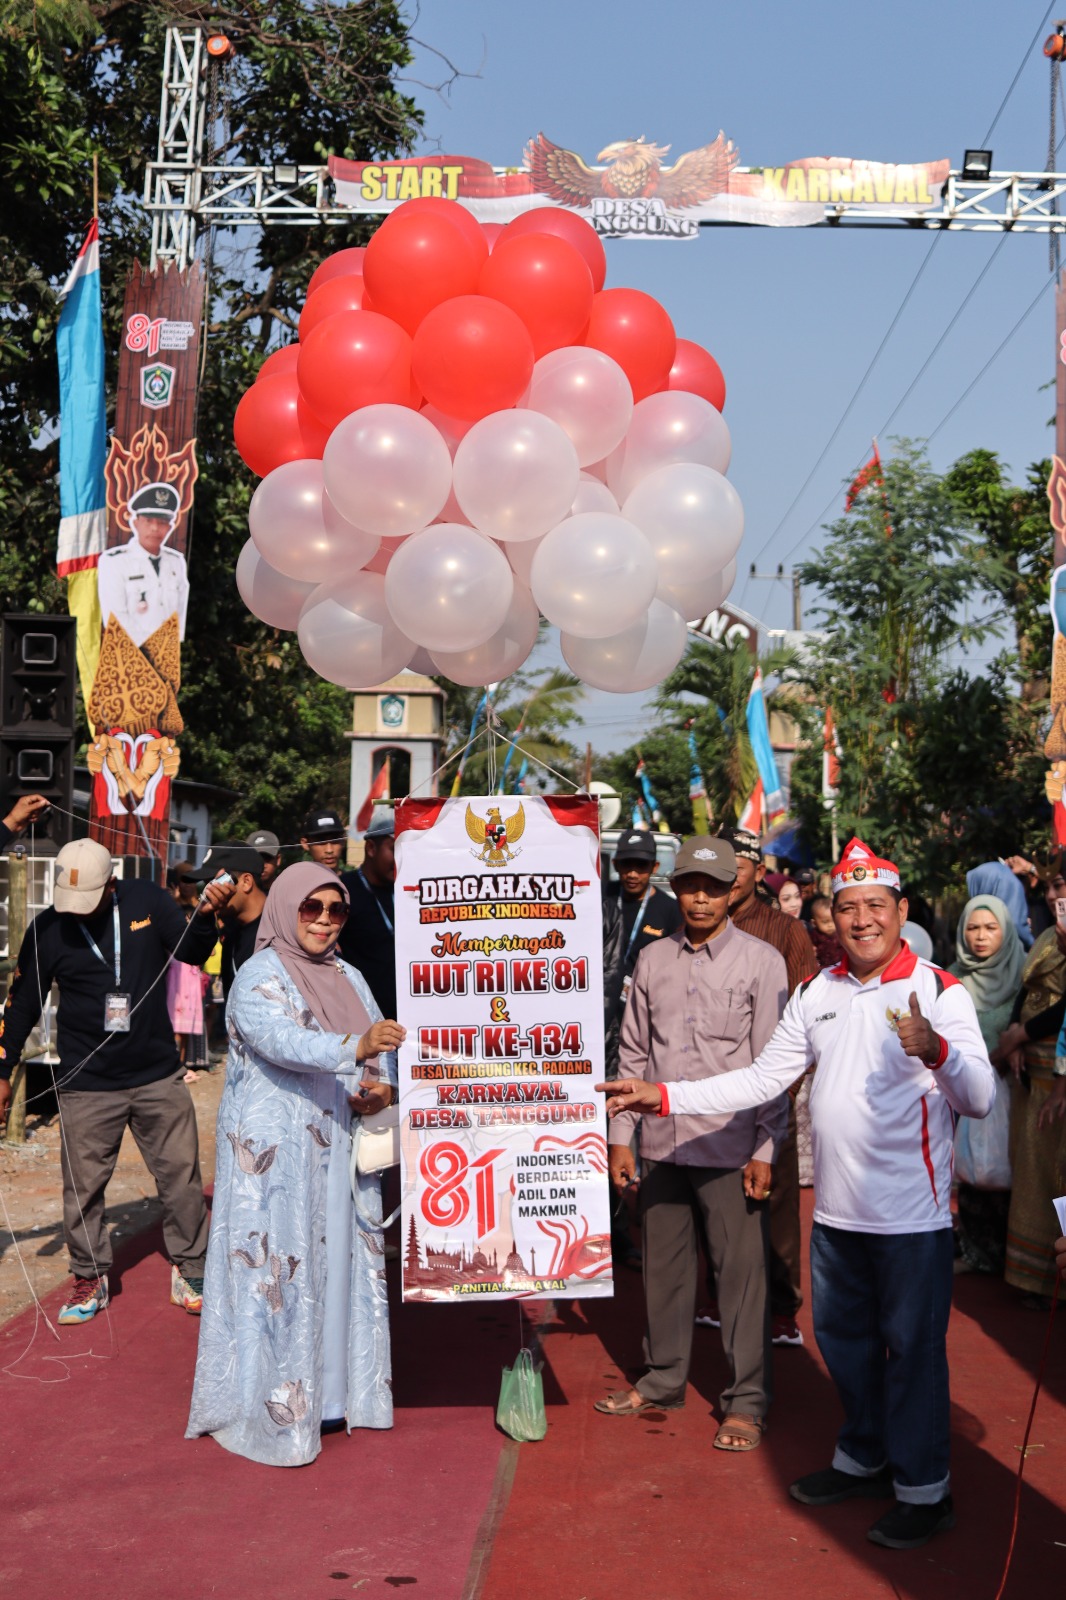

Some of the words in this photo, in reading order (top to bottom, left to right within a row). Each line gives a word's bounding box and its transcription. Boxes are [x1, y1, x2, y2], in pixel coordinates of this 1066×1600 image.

[361, 165, 464, 201] START
[762, 168, 934, 204] KARNAVAL
[594, 199, 665, 216] DESA
[584, 215, 699, 236] NGGUNG
[419, 875, 574, 904] DIRGAHAYU
[420, 905, 494, 924] REPUBLIK
[494, 903, 576, 919] INDONESIA
[431, 929, 566, 958] Memperingati
[410, 961, 471, 996] HUT
[473, 959, 507, 994] RI
[510, 958, 549, 993] KE
[551, 956, 589, 993] 81
[490, 997, 510, 1022] &
[419, 1026, 478, 1061] HUT
[482, 1022, 583, 1059] KE-134
[411, 1065, 443, 1079] DESA
[444, 1062, 511, 1078] TANGGUNG
[514, 1062, 540, 1076] KEC.
[543, 1060, 592, 1075] PADANG
[437, 1081, 568, 1106] KARNAVAL
[409, 1108, 472, 1130] DESA
[473, 1102, 597, 1128] TANGGUNG
[516, 1153, 585, 1167] INDONESIA
[419, 1140, 508, 1240] 81
[518, 1188, 546, 1201] ADIL
[549, 1187, 576, 1200] DAN
[518, 1204, 577, 1218] MAKMUR
[453, 1283, 500, 1294] PANITIA
